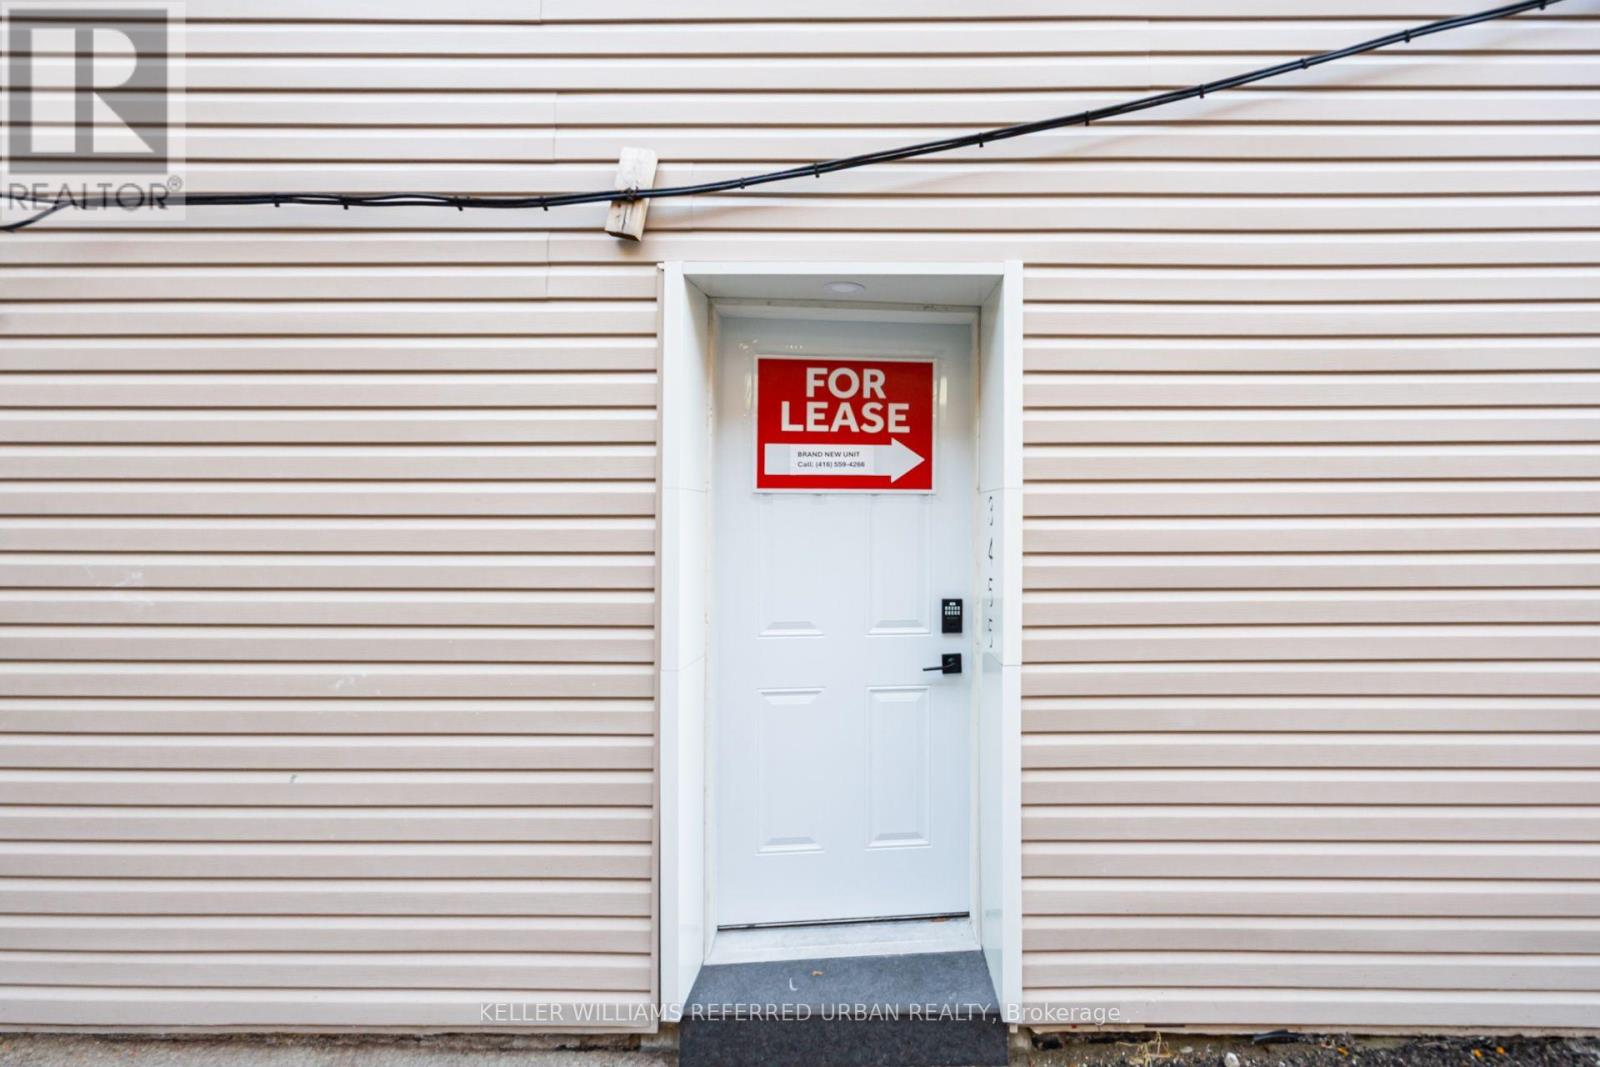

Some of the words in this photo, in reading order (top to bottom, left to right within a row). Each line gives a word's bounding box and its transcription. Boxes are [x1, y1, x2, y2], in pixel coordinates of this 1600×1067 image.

[805, 367, 887, 399] FOR
[780, 401, 911, 434] LEASE
[815, 461, 833, 469] (416)
